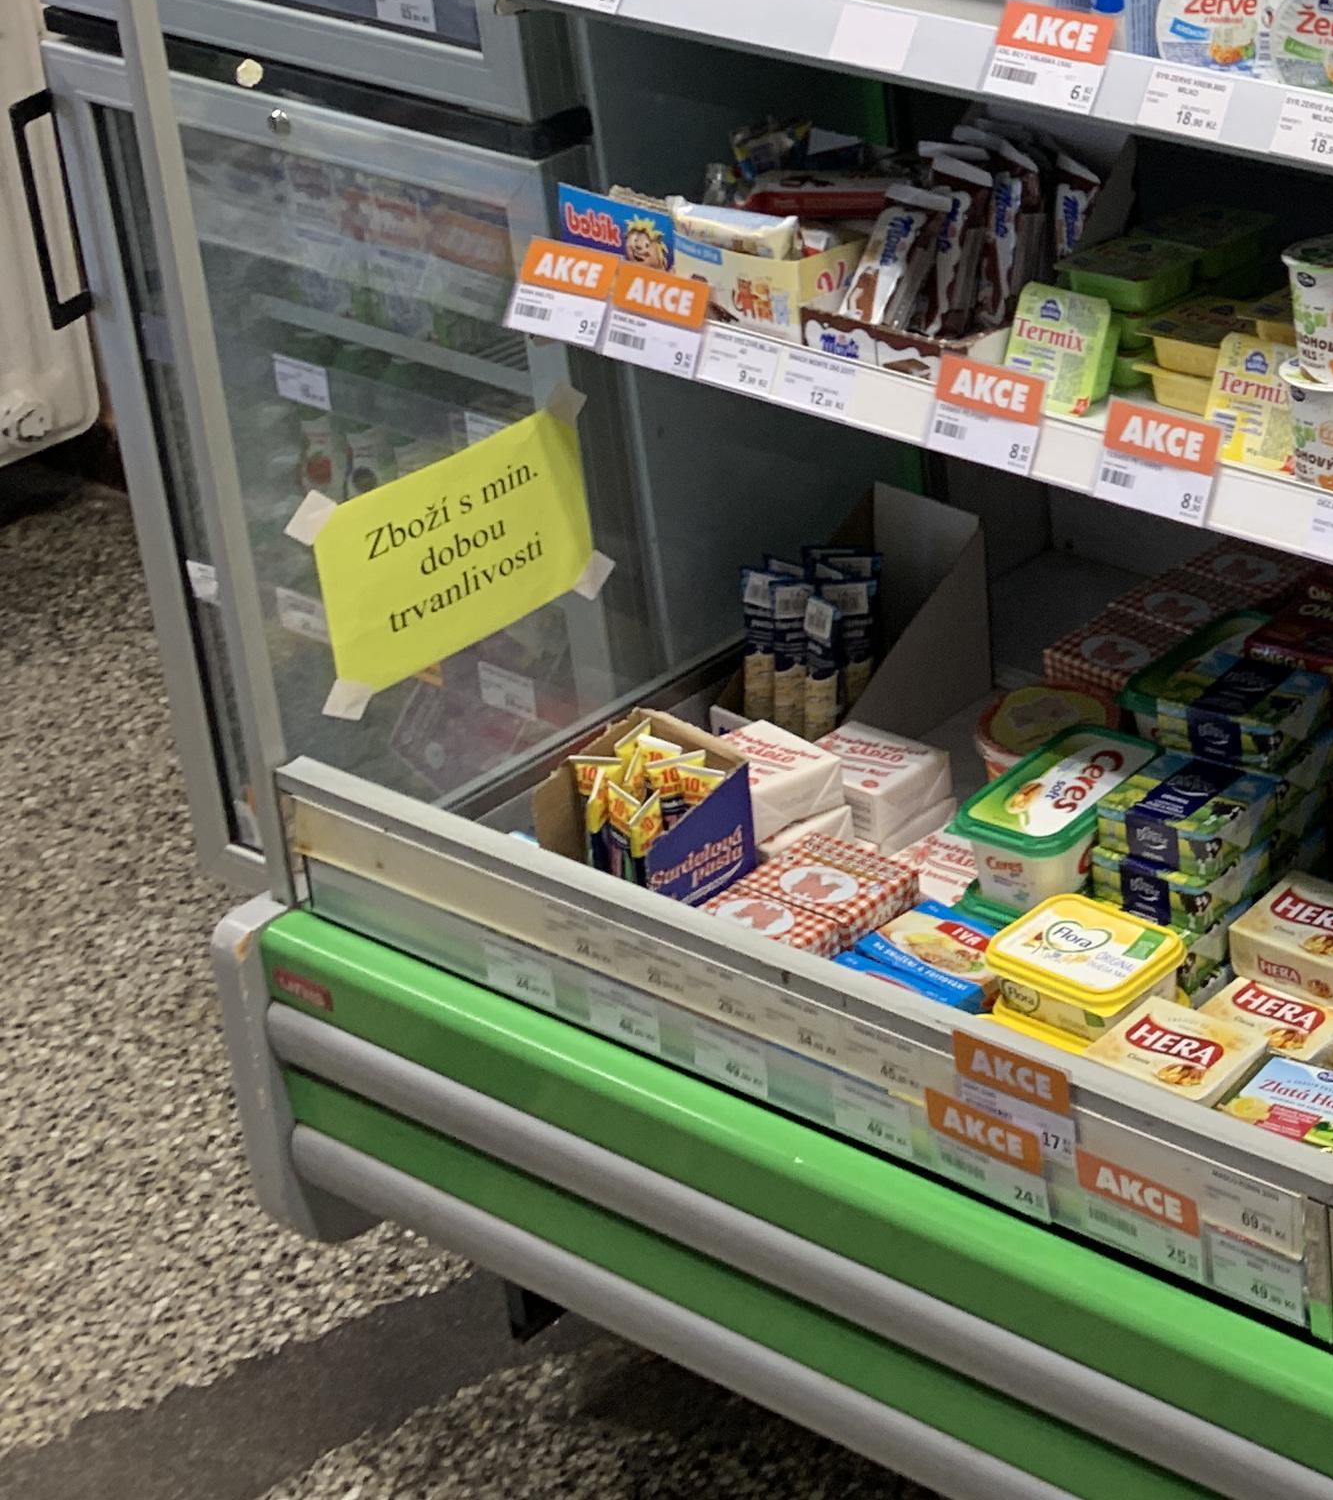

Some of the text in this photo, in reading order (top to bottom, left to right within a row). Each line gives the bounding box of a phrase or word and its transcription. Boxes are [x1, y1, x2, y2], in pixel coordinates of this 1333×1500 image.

[1013, 12, 1099, 52] AKCE
[533, 252, 602, 288] AKCE
[625, 279, 695, 315] AKCE
[1016, 317, 1085, 353] Termix
[950, 367, 1029, 413] AKCE
[1120, 414, 1205, 461] AKCE
[364, 462, 539, 562] Zboží s min.
[419, 521, 507, 578] dobou
[388, 535, 545, 634] trvanlivosti
[1051, 749, 1125, 815] Ceres
[1052, 923, 1093, 950] Flora
[1236, 983, 1321, 1030] HERA
[1131, 1022, 1220, 1069] HERA
[971, 1049, 1052, 1100] AKCE
[1258, 1076, 1305, 1102] Zlatá
[943, 1112, 1023, 1160] AKCE
[1095, 1167, 1183, 1224] AKCE
